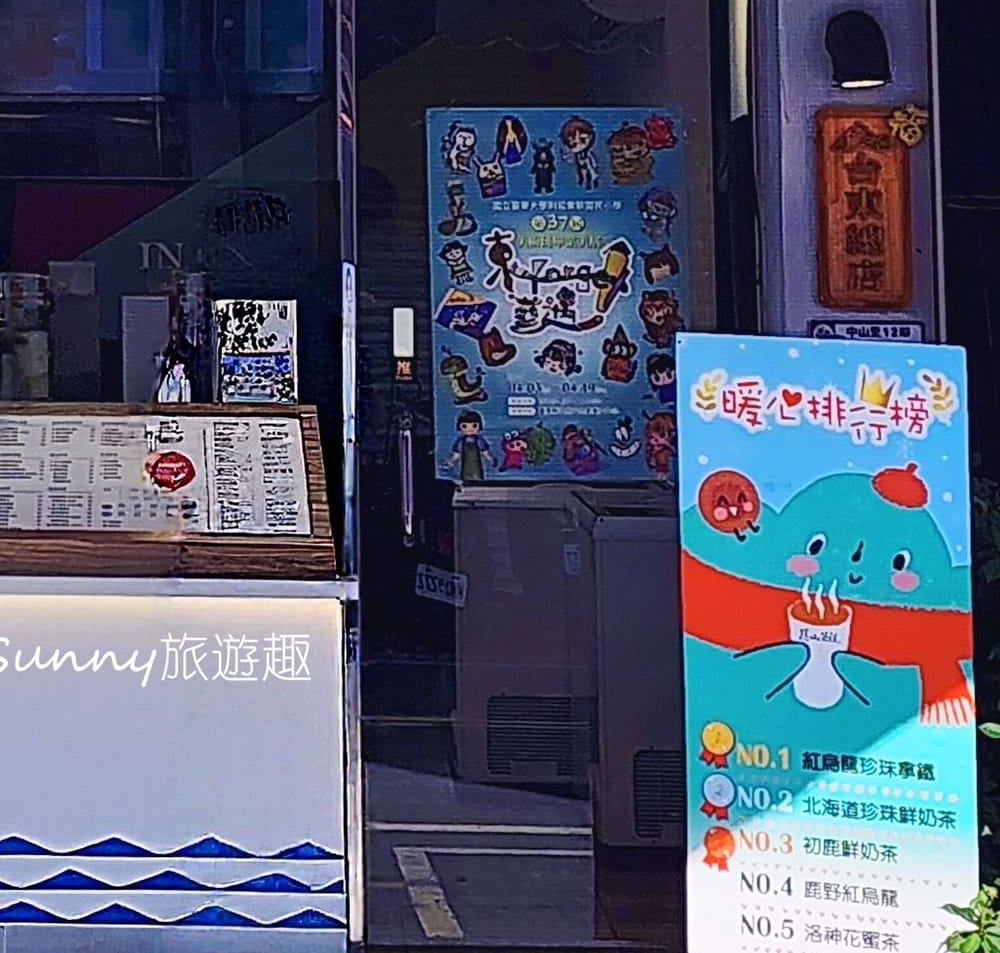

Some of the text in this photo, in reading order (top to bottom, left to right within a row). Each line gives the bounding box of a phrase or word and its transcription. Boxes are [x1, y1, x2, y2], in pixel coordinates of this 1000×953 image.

[137, 241, 184, 271] IN
[722, 381, 930, 441] 暖心排行榜
[737, 744, 936, 782] NO.1 紅烏龍珍珠拿鐵
[737, 785, 957, 830] NO.2 北海道珍珠鮮奶茶
[739, 829, 899, 864] NO.3 初鹿鮮奶茶
[740, 872, 899, 908] NO.4 鹿野紅烏龍
[740, 914, 900, 953] NO.5 洛神花蜜茶
